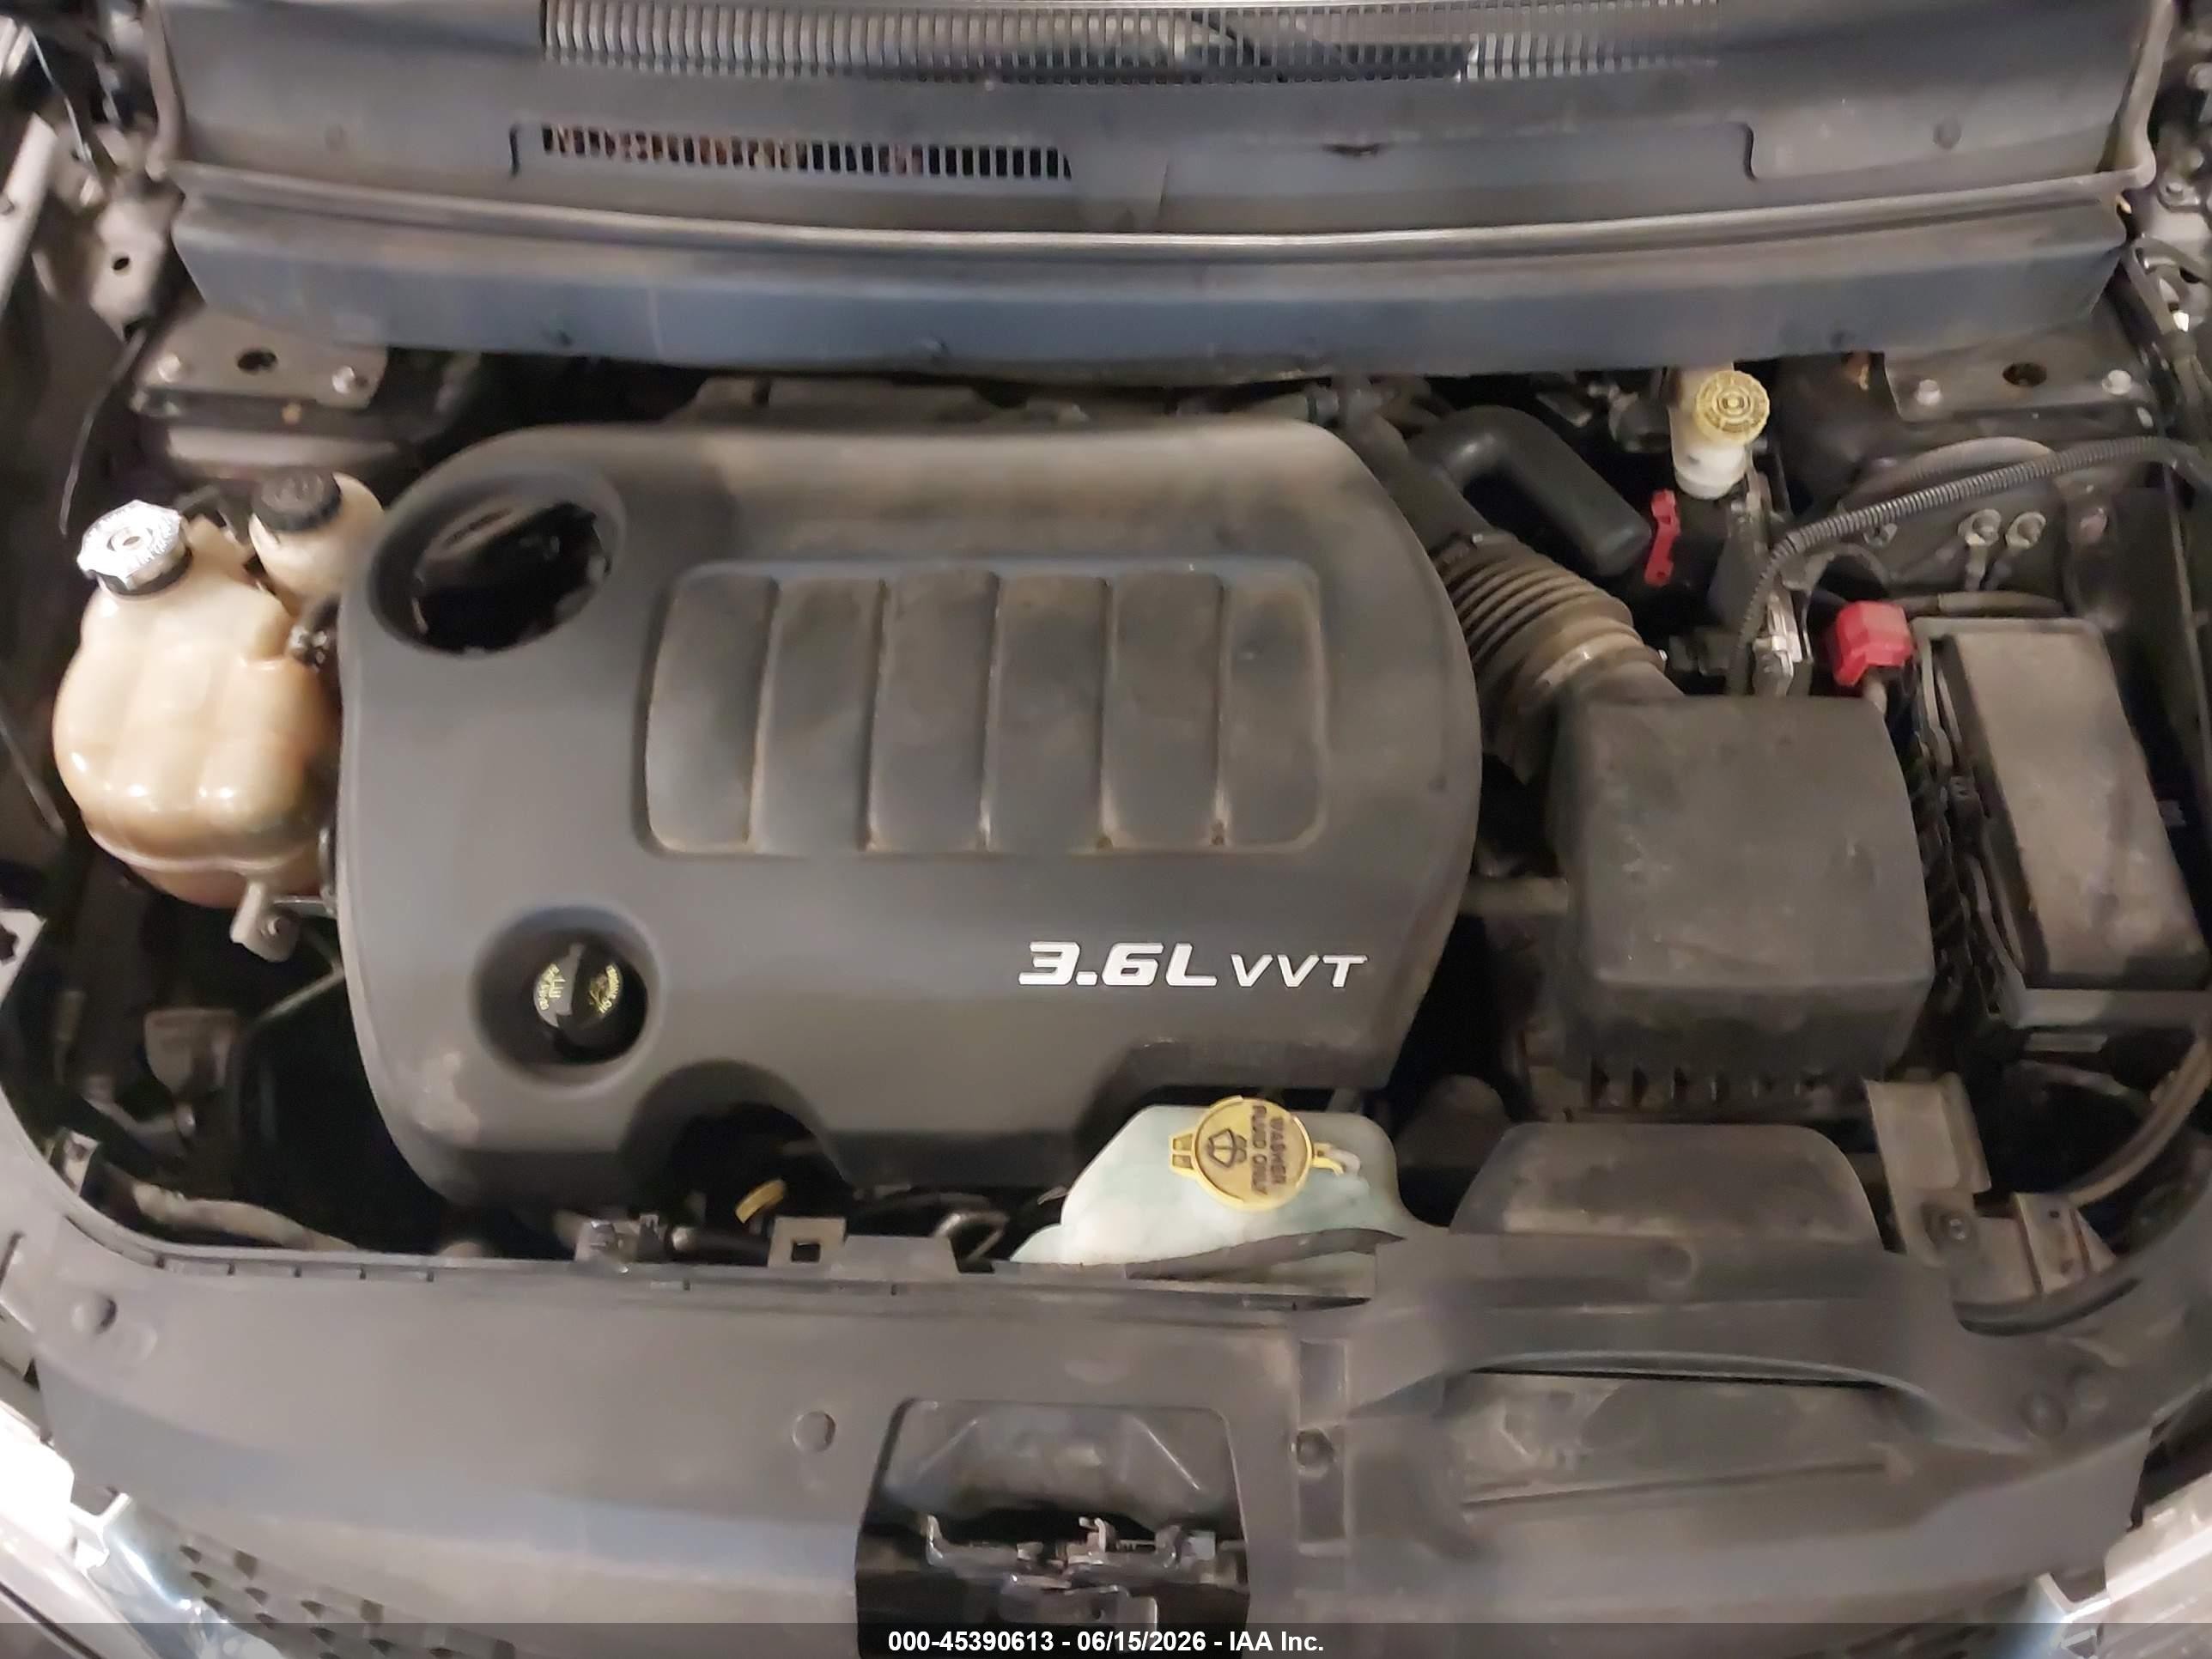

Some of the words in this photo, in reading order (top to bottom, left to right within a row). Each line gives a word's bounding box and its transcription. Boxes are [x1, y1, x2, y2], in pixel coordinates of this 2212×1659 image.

[1018, 941, 1218, 987] 3.6L
[1230, 953, 1369, 988] VVT
[1270, 1117, 1286, 1183] WASHER
